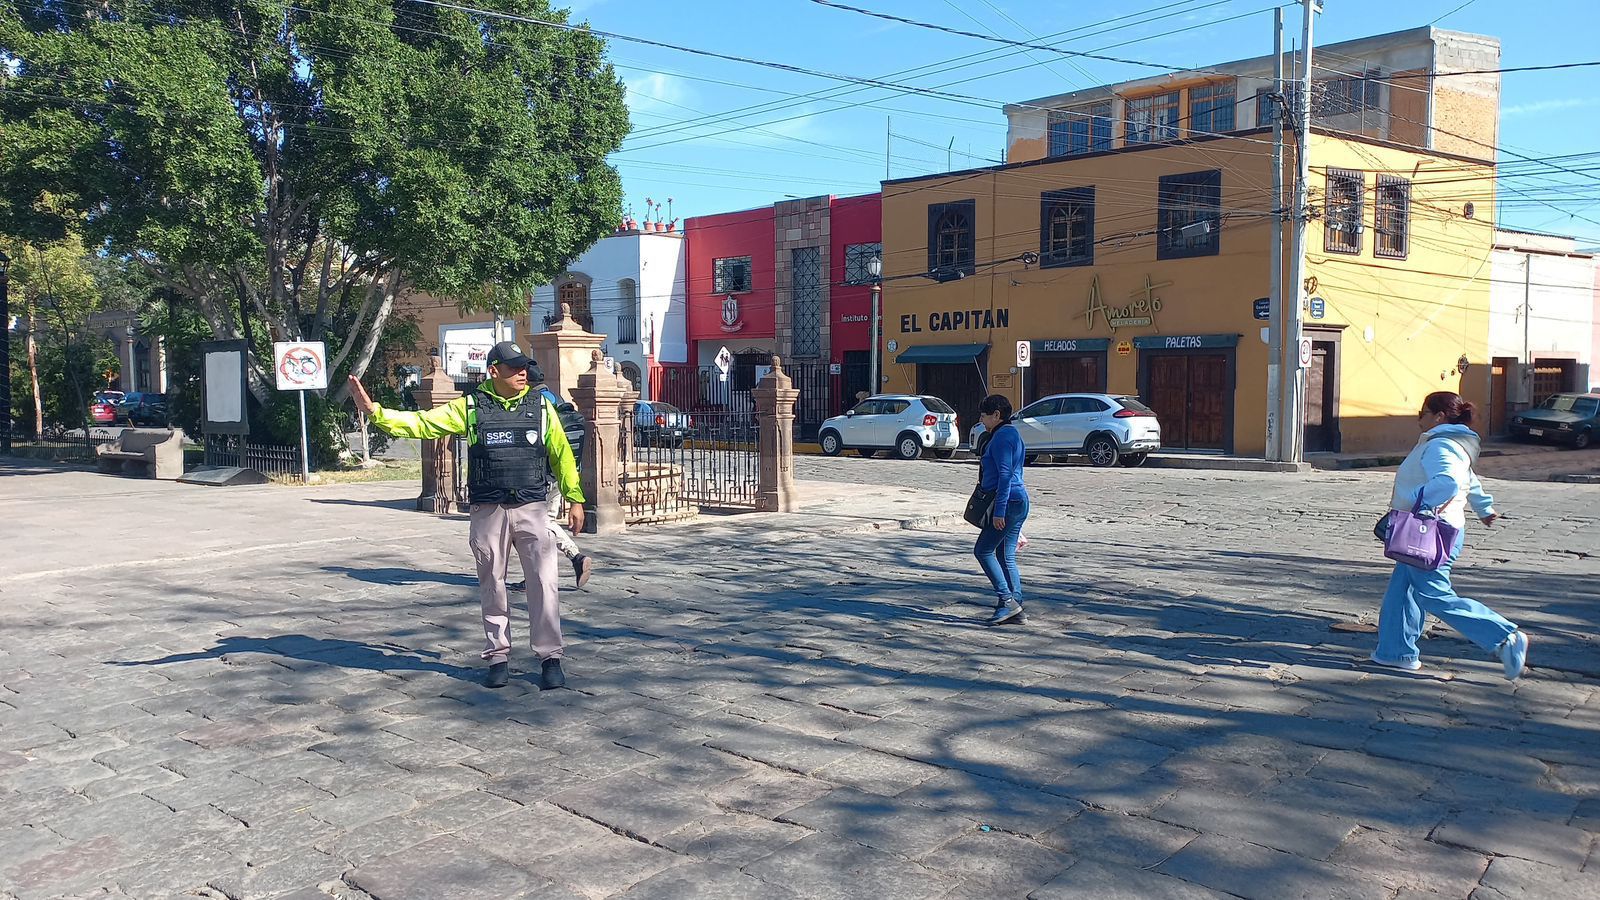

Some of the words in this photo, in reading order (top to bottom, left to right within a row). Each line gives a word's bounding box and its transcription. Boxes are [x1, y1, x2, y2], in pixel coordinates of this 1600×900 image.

[841, 313, 868, 322] Instituto
[900, 314, 921, 333] EL
[1044, 340, 1077, 351] HELADOS
[1165, 335, 1202, 348] PALETAS
[468, 352, 487, 361] VENTA
[486, 431, 512, 440] SSPC
